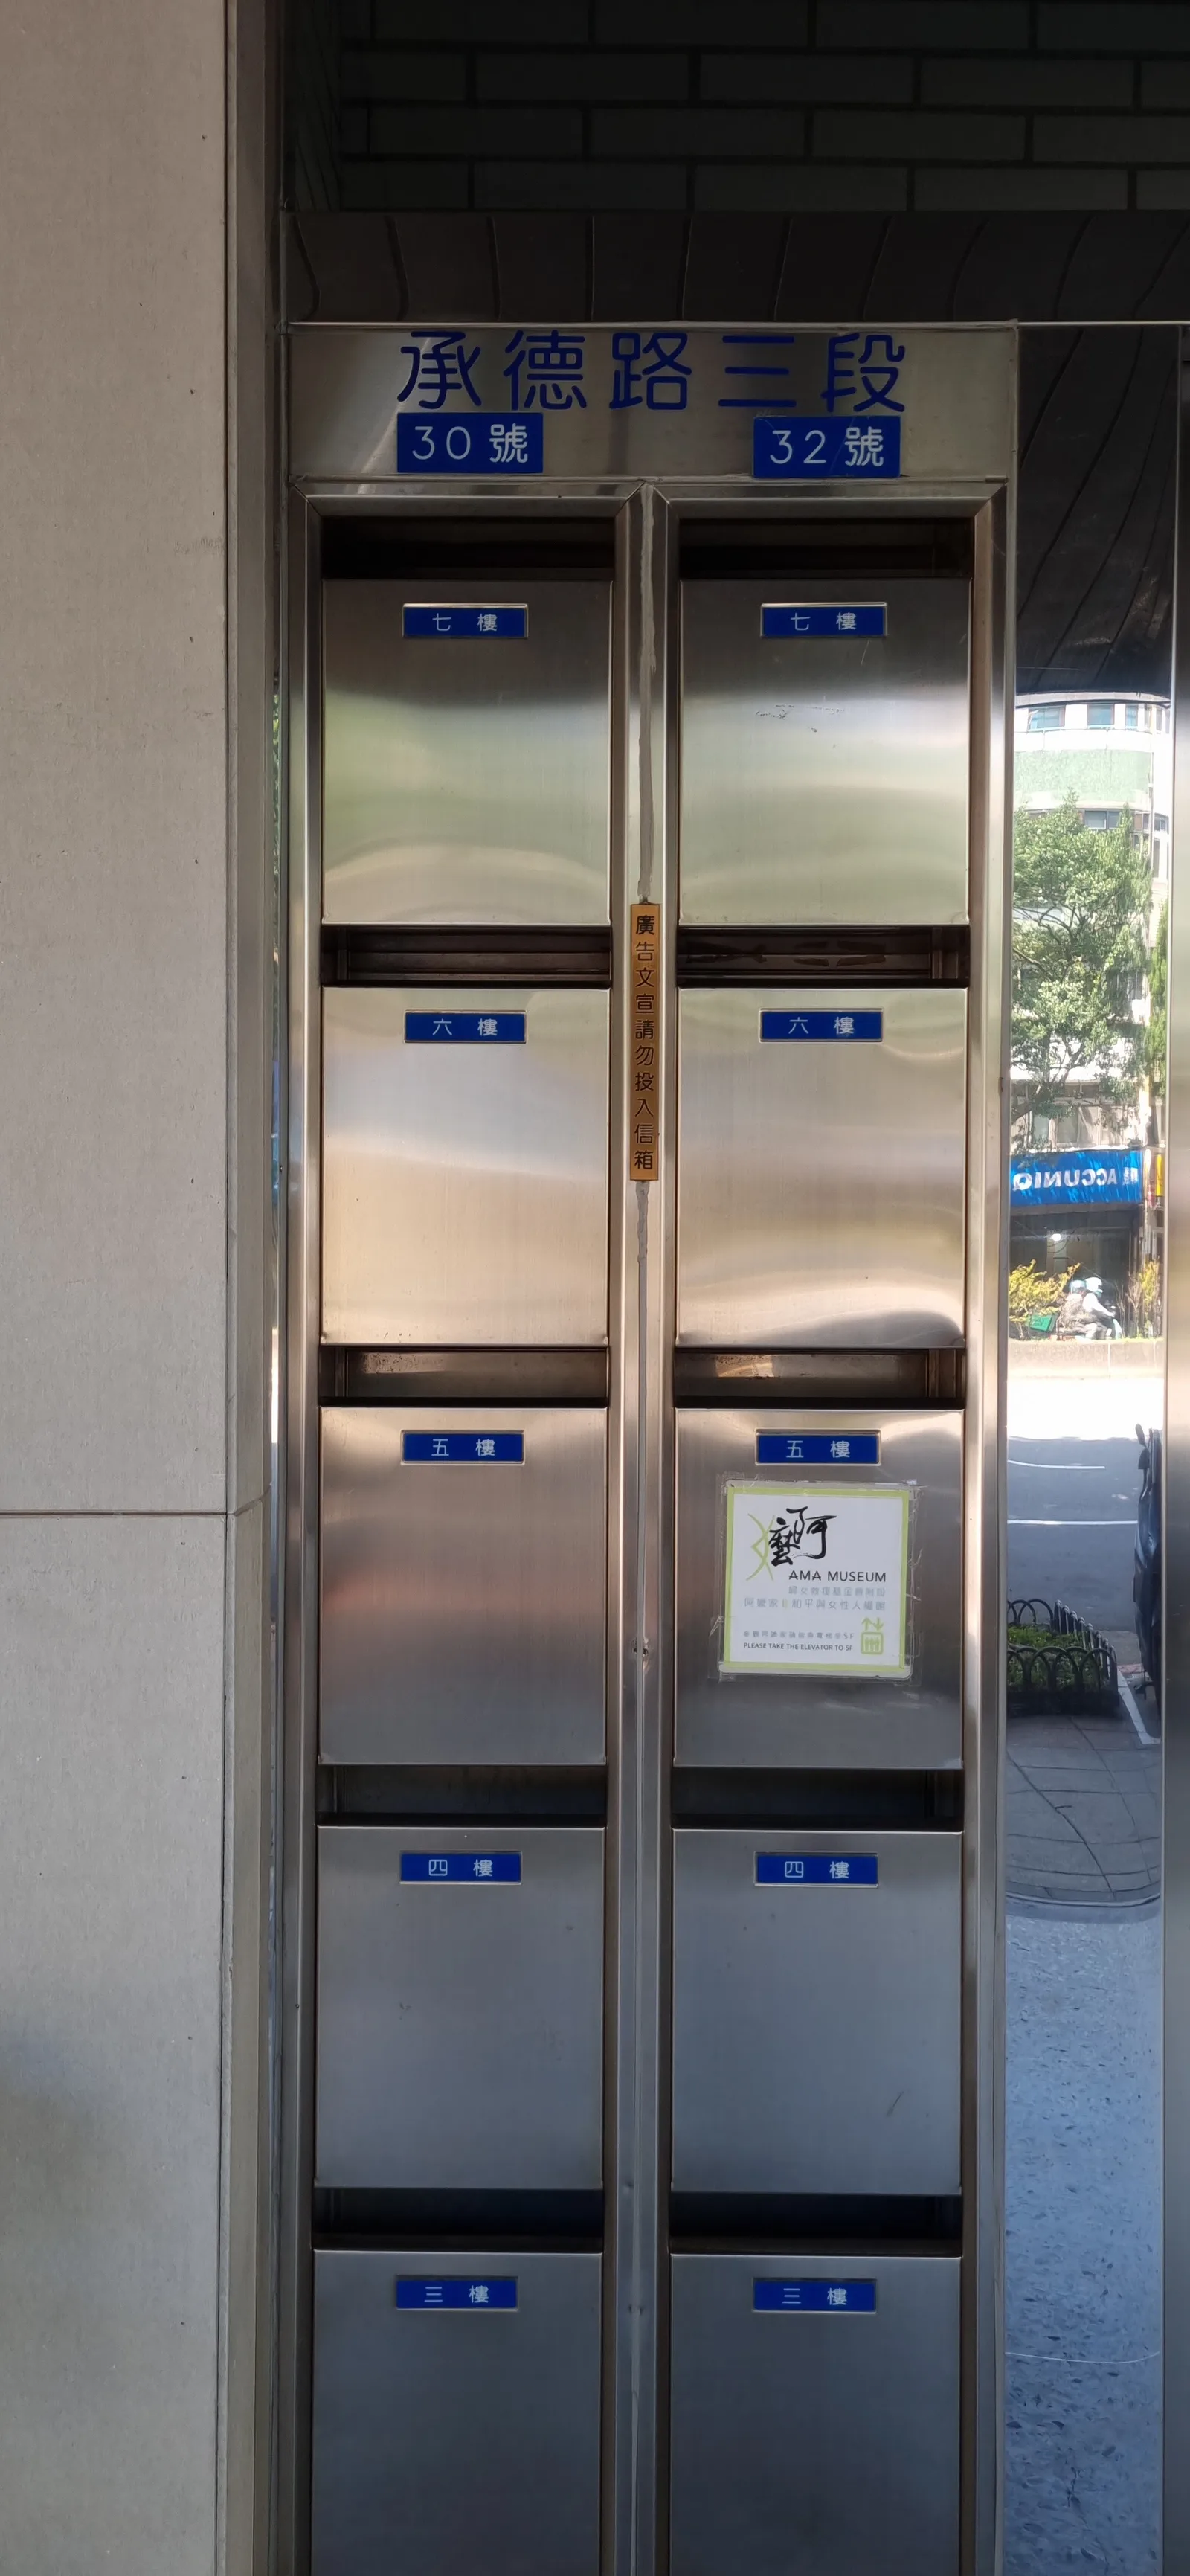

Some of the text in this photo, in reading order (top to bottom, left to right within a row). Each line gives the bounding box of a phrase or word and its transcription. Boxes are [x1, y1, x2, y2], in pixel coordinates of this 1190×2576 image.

[396, 330, 906, 413] 承德路三段
[432, 613, 498, 632] 七樓
[791, 612, 857, 631] 七樓
[432, 1018, 498, 1036] 六樓
[788, 1017, 854, 1035] 六樓
[634, 915, 655, 1170] 廣告文宣請勿投入信箱
[431, 1439, 495, 1456] 五樓
[785, 1439, 851, 1459] 五樓
[788, 1570, 887, 1582] AMA MUSEUM
[427, 1859, 493, 1878] 四樓
[783, 1860, 850, 1880] 四樓
[424, 2284, 489, 2304] 三樓
[782, 2287, 848, 2307] 三樓
